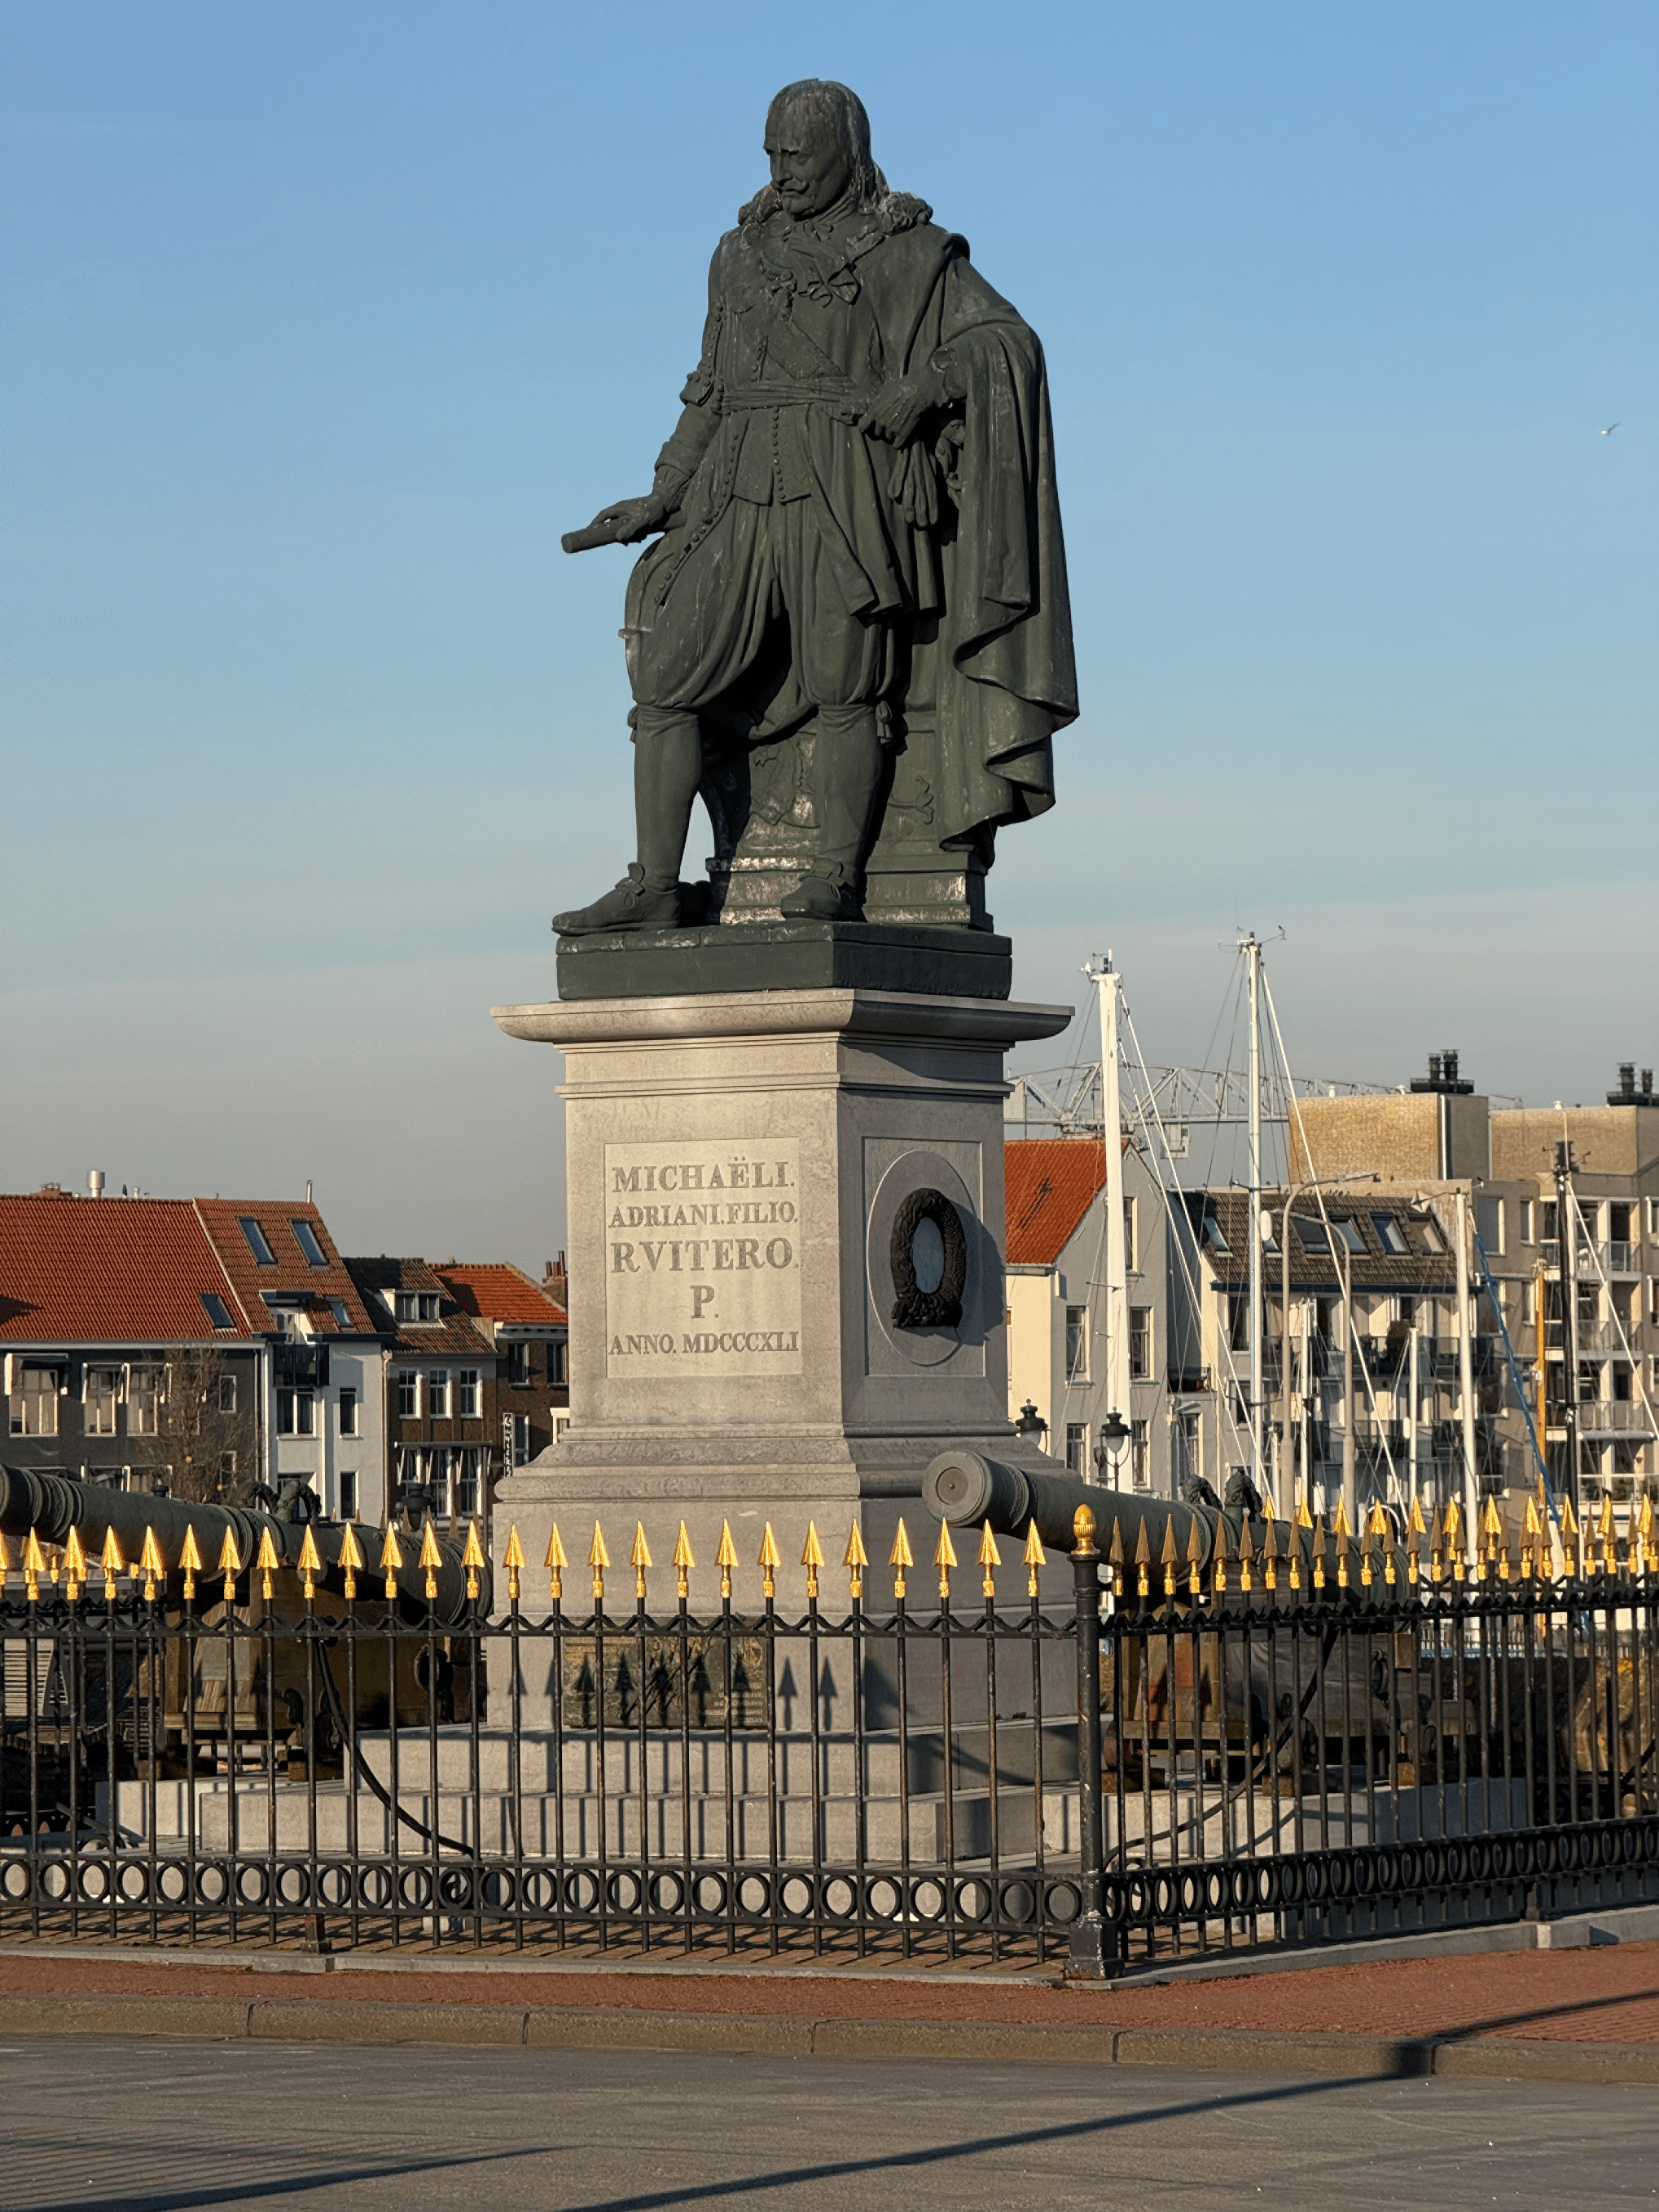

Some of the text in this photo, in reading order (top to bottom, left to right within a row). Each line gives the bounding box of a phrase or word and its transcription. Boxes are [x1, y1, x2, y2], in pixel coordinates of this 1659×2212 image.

[612, 1156, 795, 1193] MICHAËLI.
[610, 1237, 799, 1273] RVITERO.
[690, 1285, 719, 1319] P.
[608, 1331, 799, 1355] ANNO. MDCCCXLI
